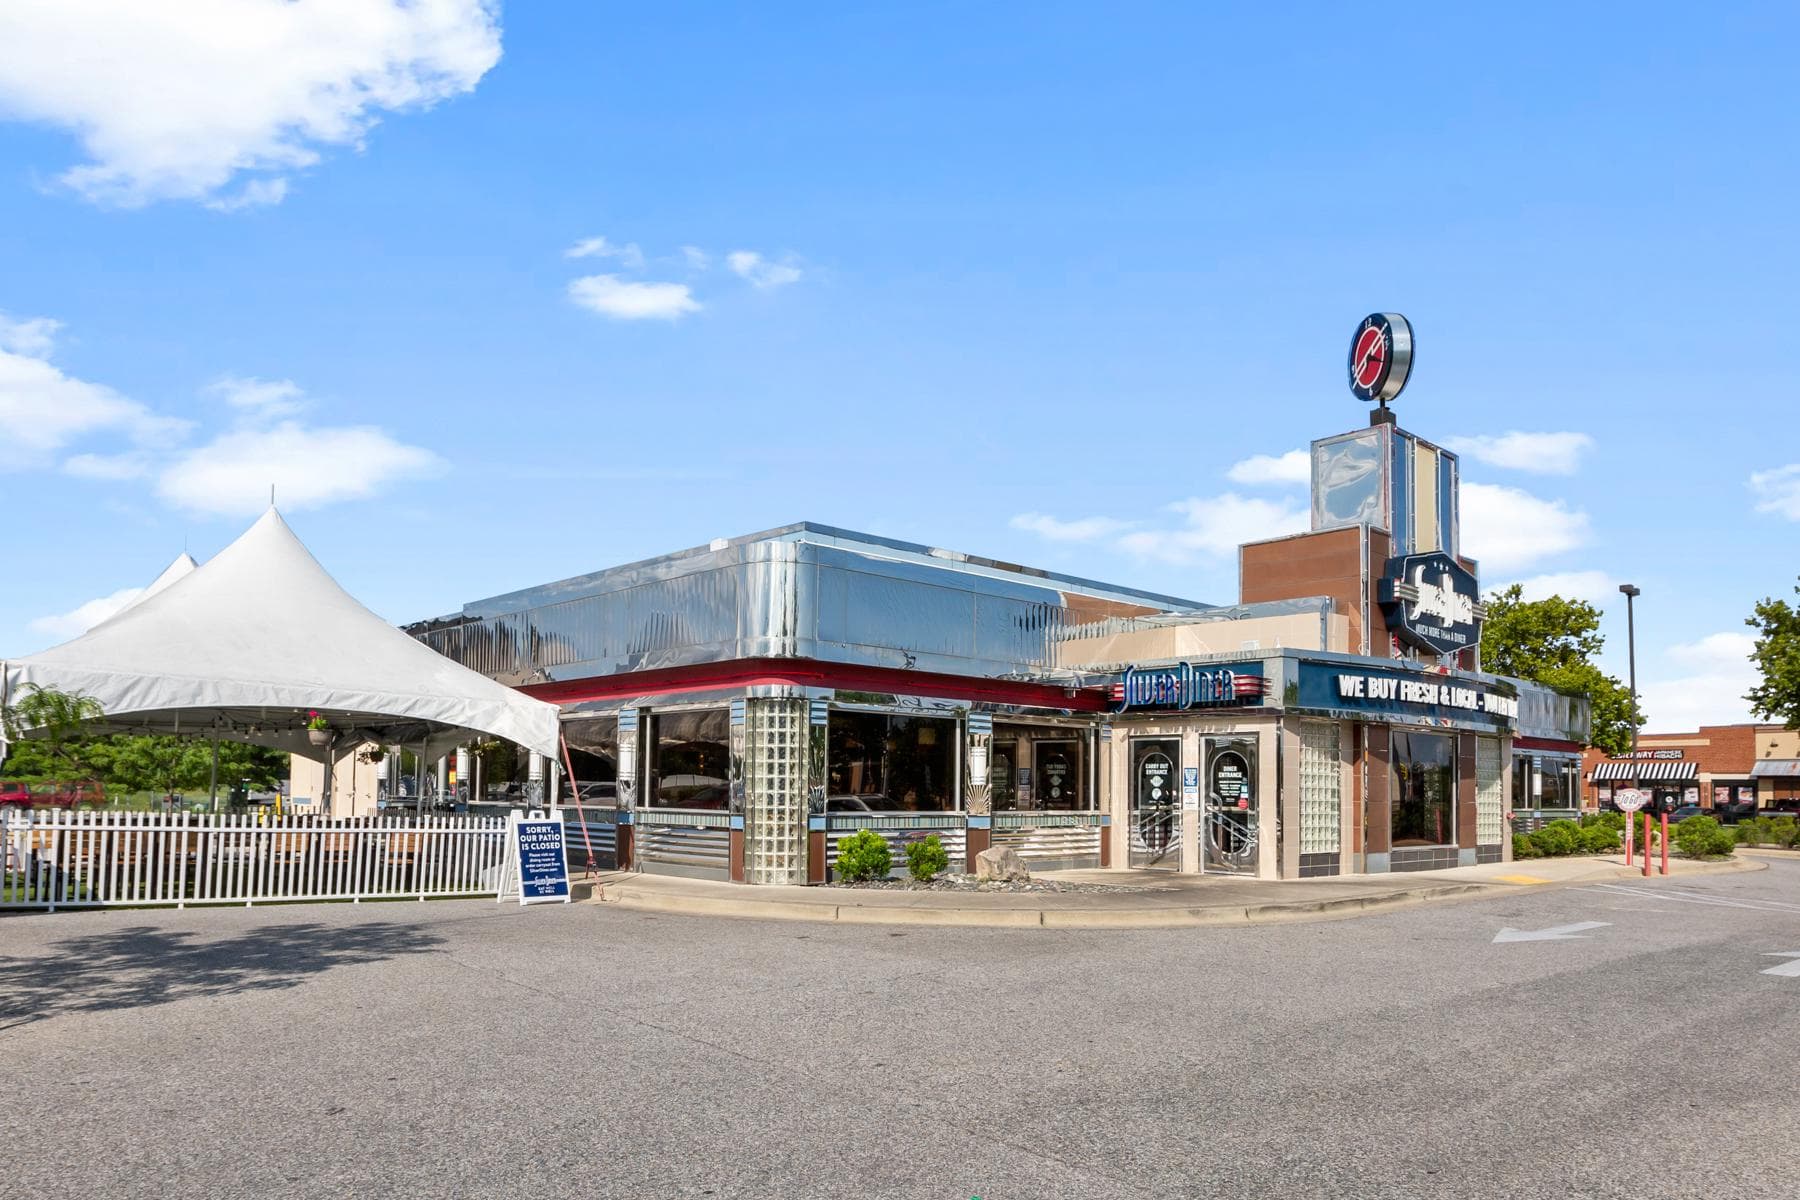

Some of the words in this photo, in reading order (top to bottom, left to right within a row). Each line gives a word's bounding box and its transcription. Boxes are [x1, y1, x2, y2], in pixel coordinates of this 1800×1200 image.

[1338, 674, 1364, 697] WE
[1367, 676, 1398, 699] BUY
[1400, 680, 1438, 704] FRESH
[1440, 684, 1450, 705] &
[1451, 686, 1478, 710] LOCAL
